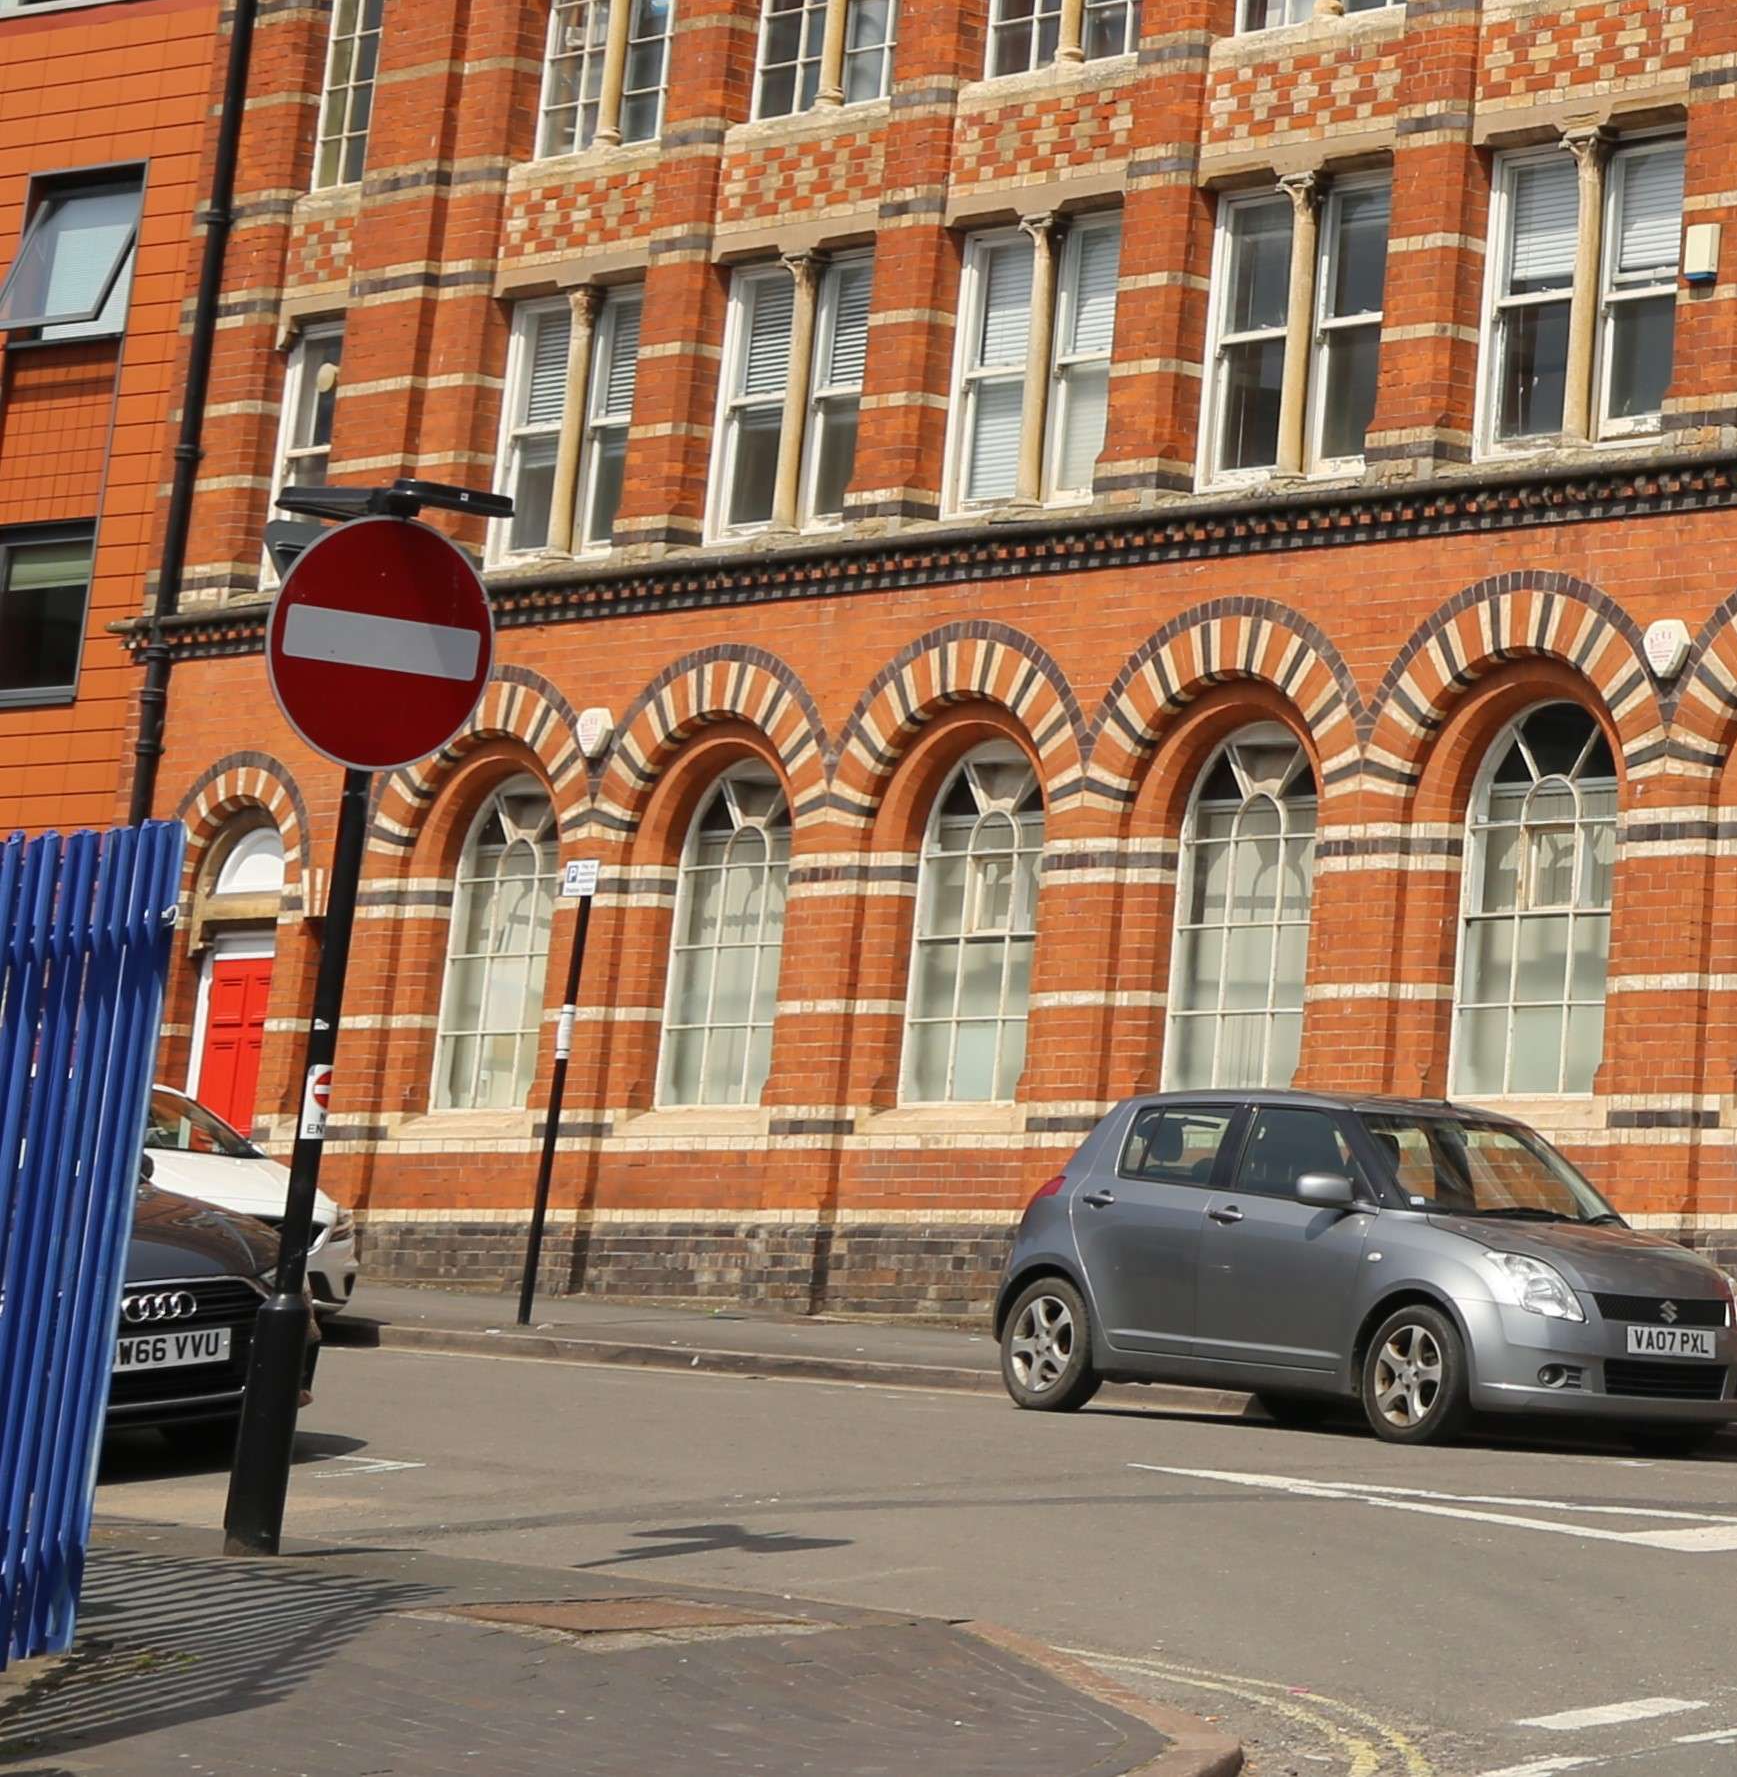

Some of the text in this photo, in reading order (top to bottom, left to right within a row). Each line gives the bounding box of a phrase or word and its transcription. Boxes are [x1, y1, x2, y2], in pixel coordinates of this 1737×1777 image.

[119, 1332, 220, 1366] W66 VVU
[1634, 1329, 1709, 1354] VA07 PXL
